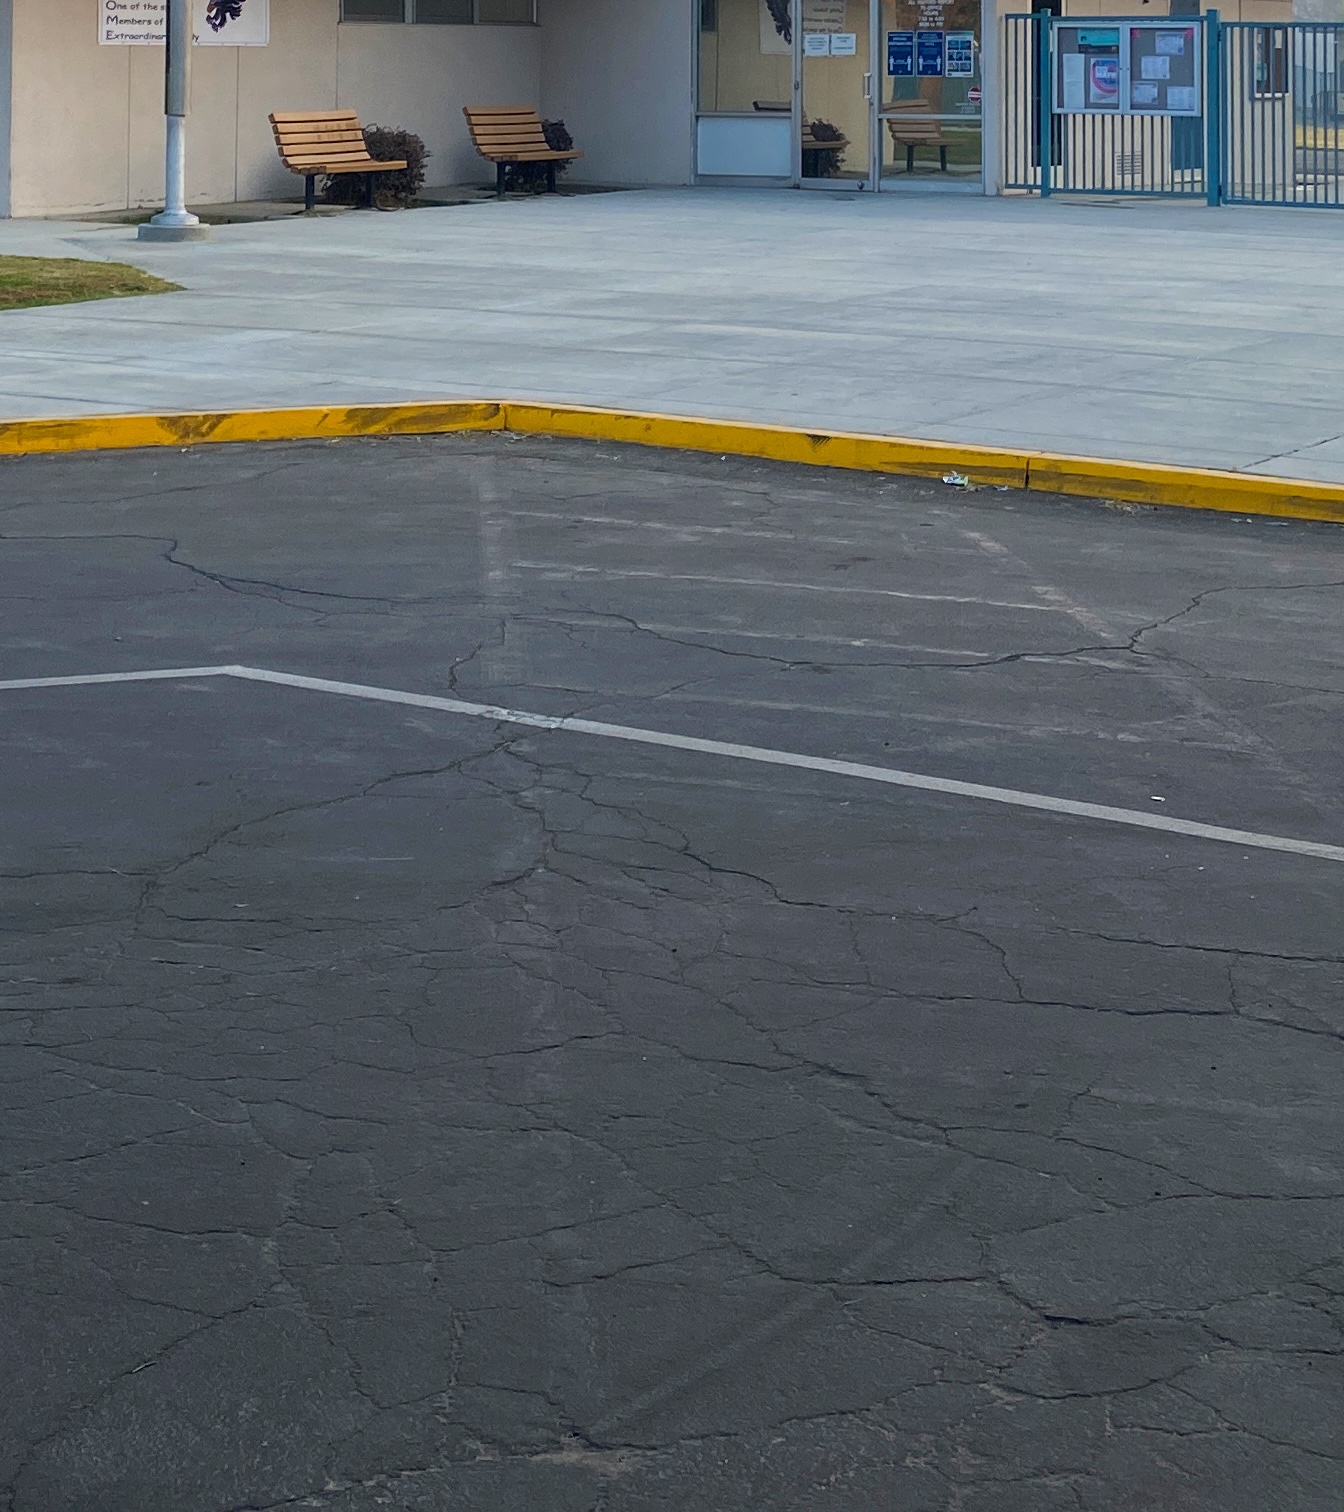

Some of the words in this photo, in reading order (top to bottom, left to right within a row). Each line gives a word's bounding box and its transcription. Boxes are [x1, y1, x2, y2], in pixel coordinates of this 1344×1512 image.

[106, 0, 127, 10] One
[143, 3, 158, 11] the
[106, 15, 152, 25] Members
[154, 17, 164, 26] of
